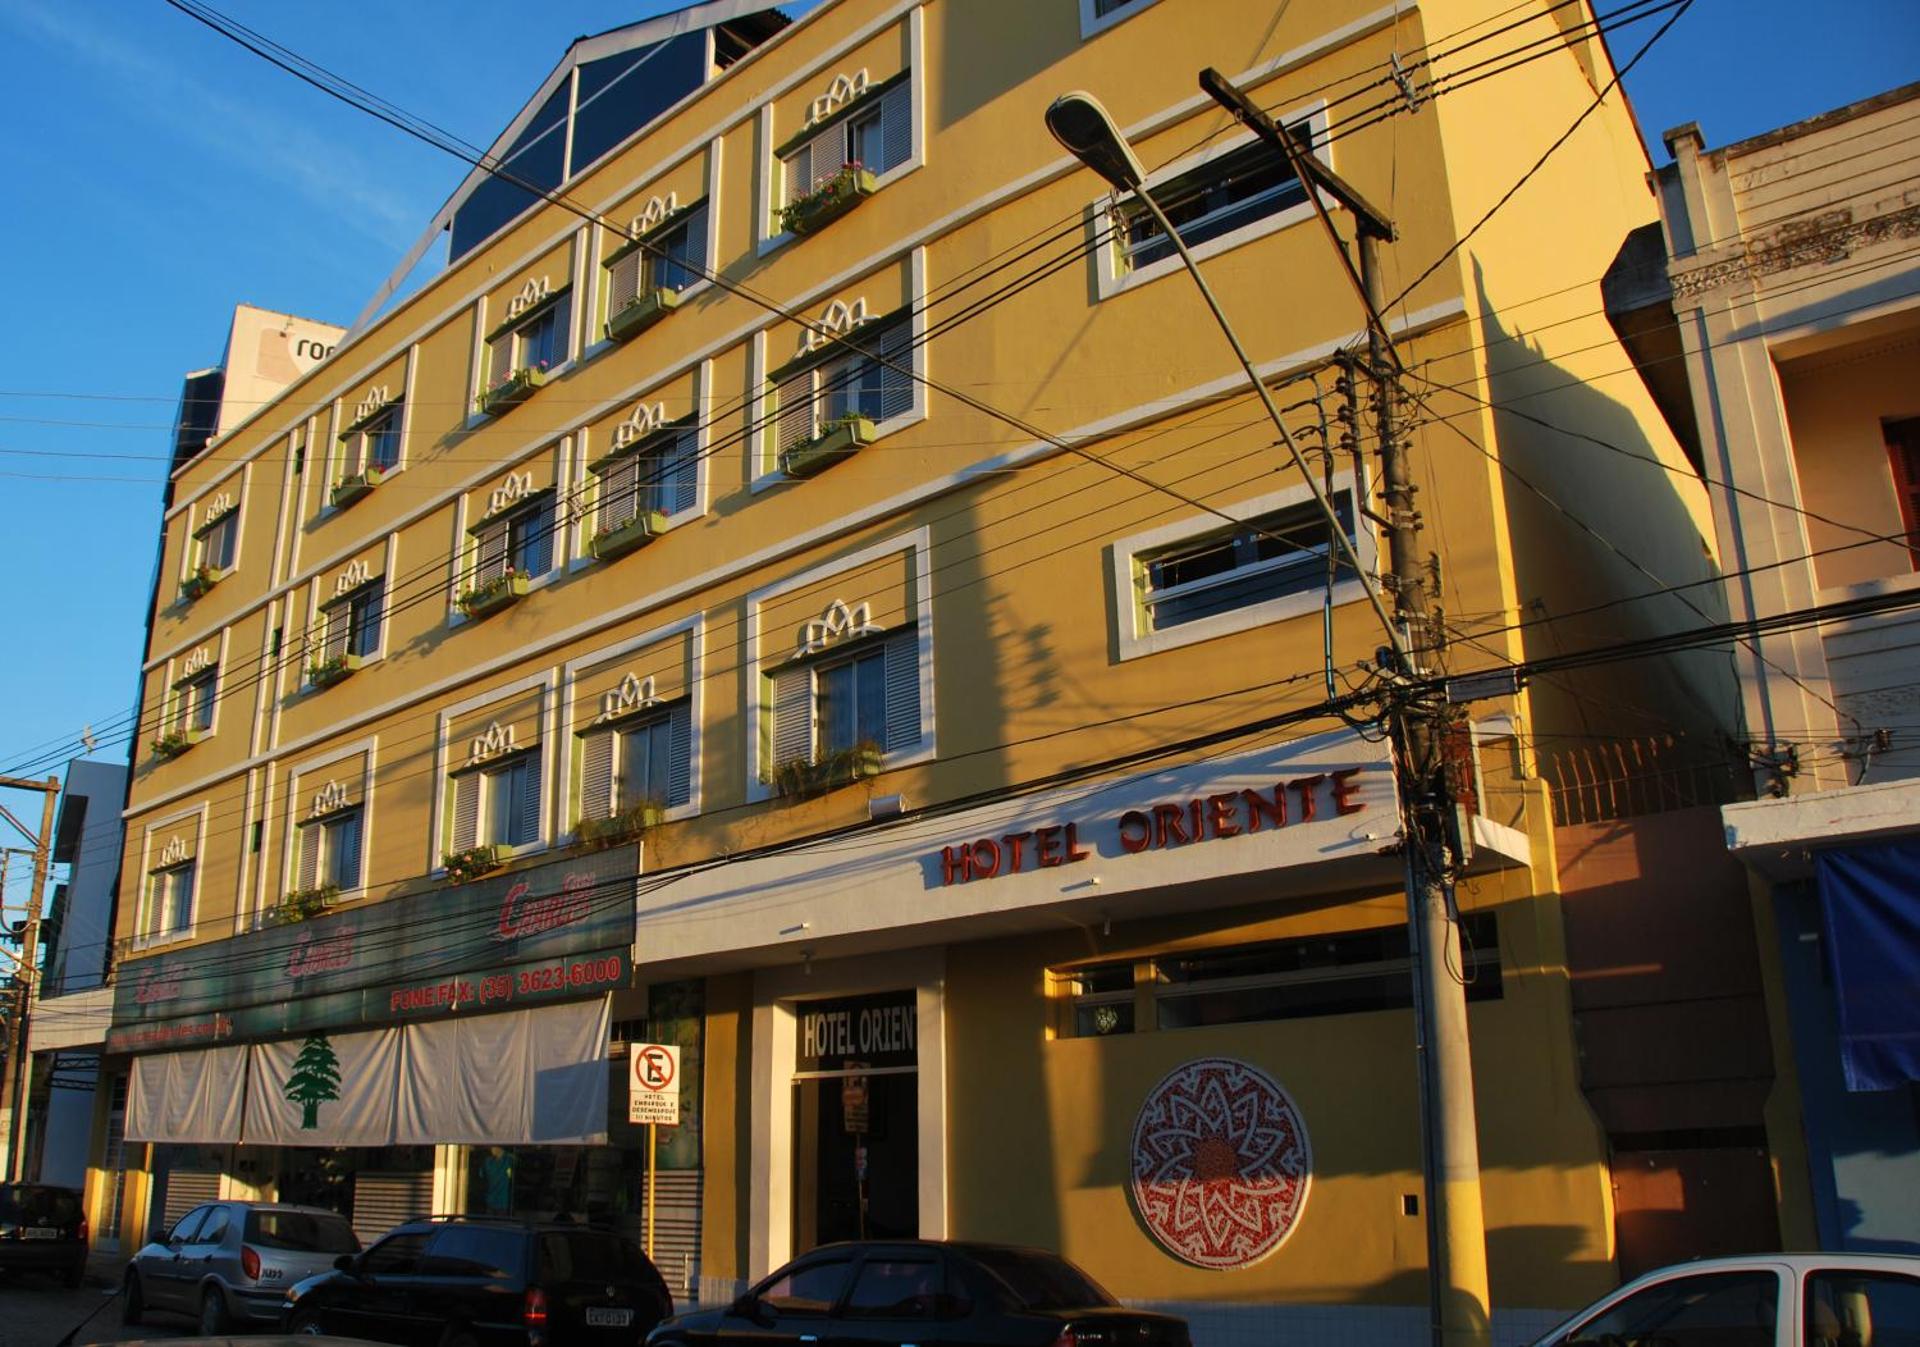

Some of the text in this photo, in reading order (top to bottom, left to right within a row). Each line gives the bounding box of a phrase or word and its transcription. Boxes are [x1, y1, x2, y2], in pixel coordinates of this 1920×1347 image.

[940, 766, 1368, 887] HOTEL ORIENTE
[479, 974, 514, 1005] (35)
[520, 956, 621, 993] 3623-6000
[804, 1005, 917, 1058] HOTEL ORIEN
